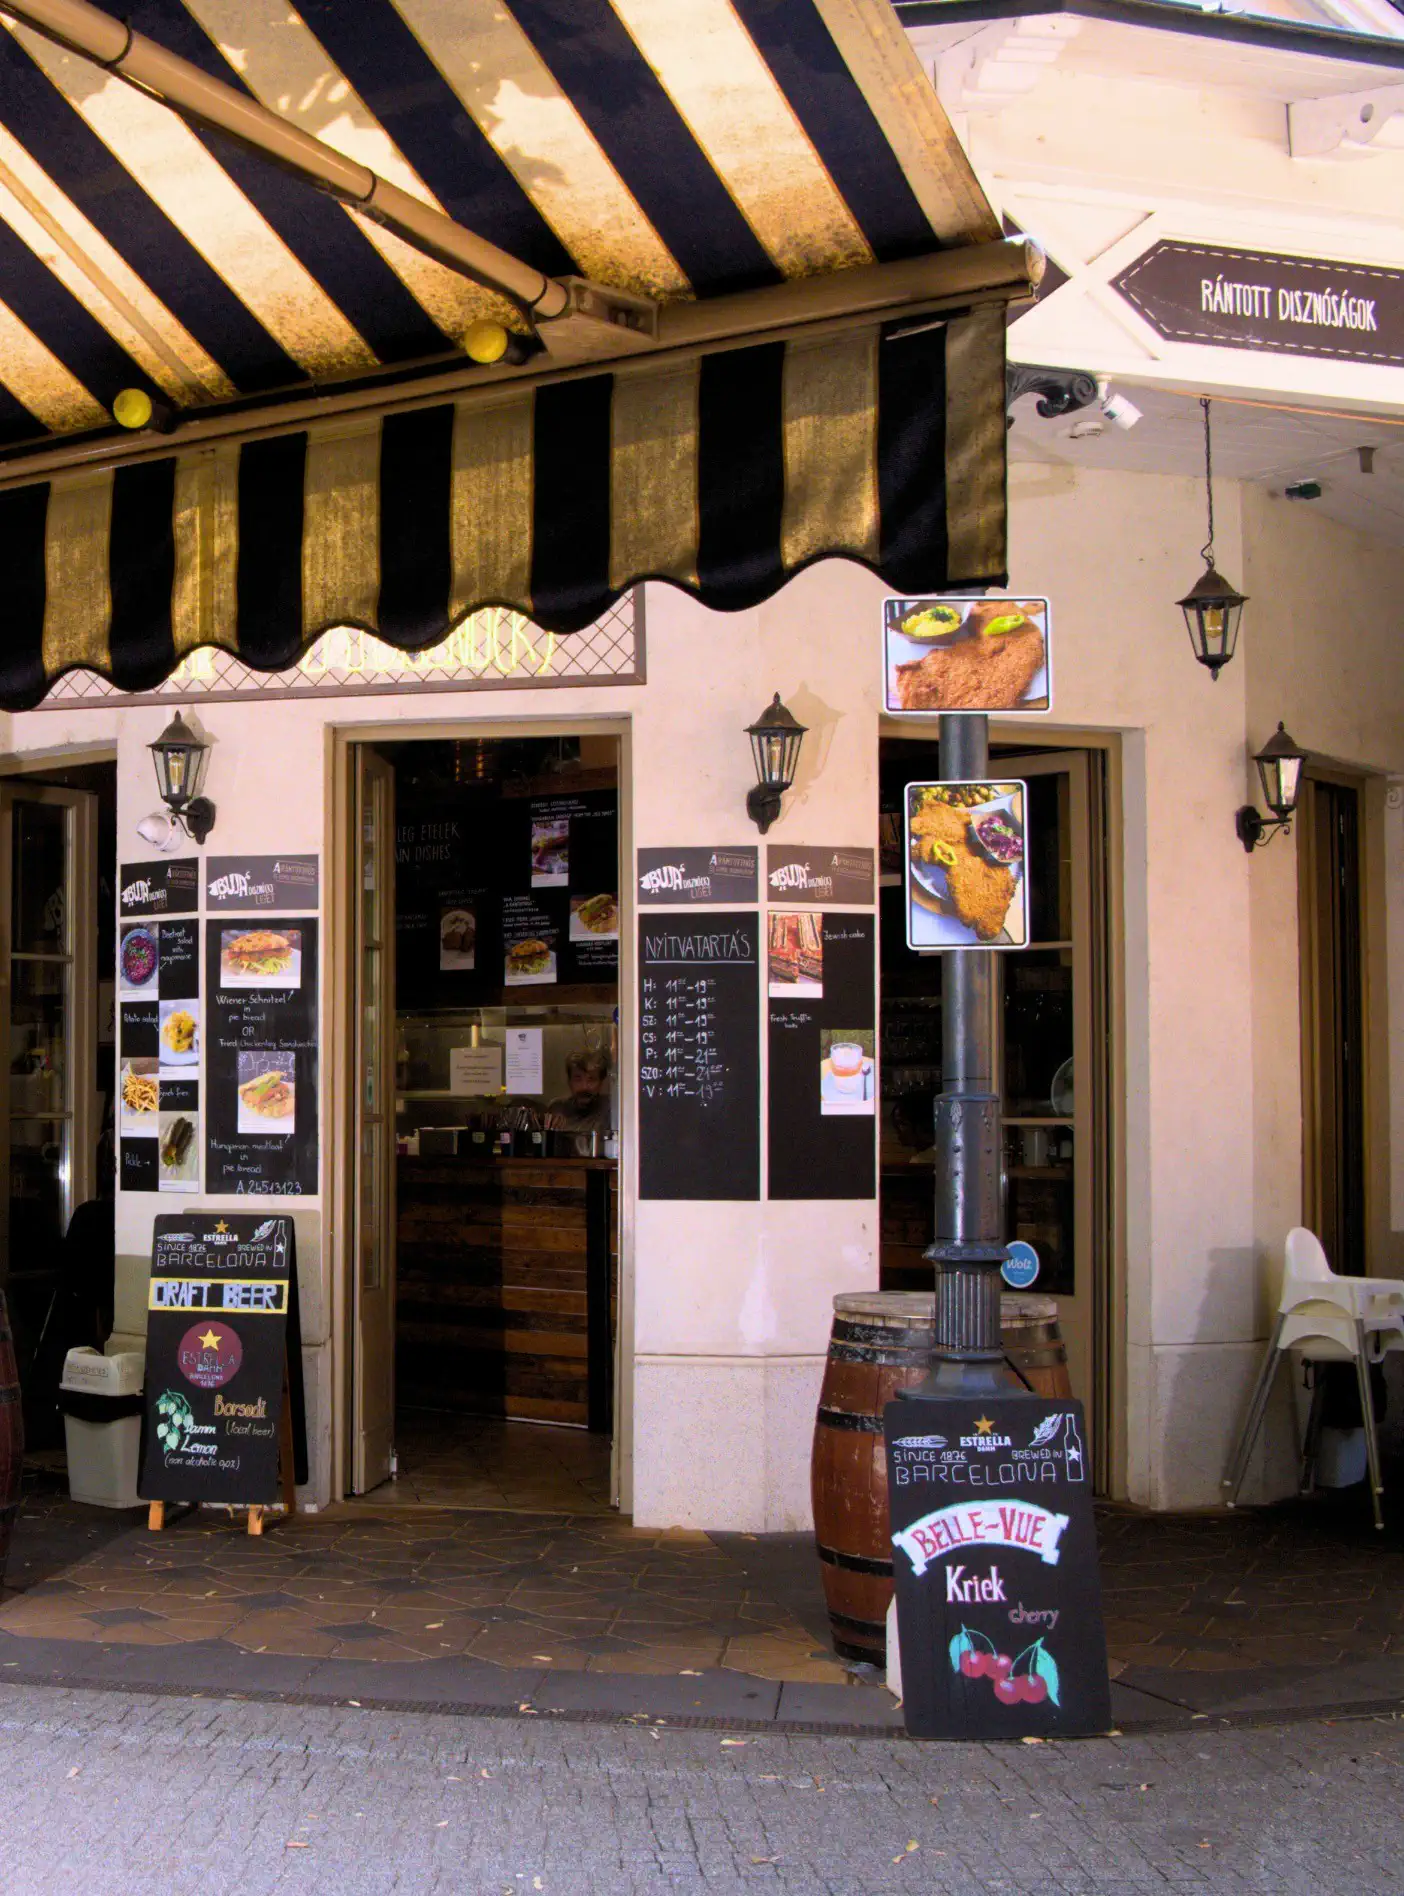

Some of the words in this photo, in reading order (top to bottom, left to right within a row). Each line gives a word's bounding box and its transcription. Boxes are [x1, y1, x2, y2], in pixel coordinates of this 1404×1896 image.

[1200, 273, 1271, 319] RÁNTOTT
[1277, 287, 1378, 331] DISZNÓSÁGOK
[643, 978, 656, 993] H:
[216, 995, 246, 1006] Wiener
[248, 993, 286, 1004] Schnitzel
[644, 997, 657, 1010] K:
[641, 1015, 657, 1027] SZ:
[242, 1026, 255, 1037] OR
[642, 1032, 657, 1044] CS:
[645, 1047, 658, 1060] P:
[640, 1065, 663, 1081] SZO:
[240, 1152, 248, 1160] in
[203, 1233, 238, 1242] ESTRELLA
[157, 1243, 185, 1252] SINCE
[236, 1243, 264, 1252] BREWED
[265, 1243, 273, 1251] IN
[156, 1252, 266, 1268] BARCELONA
[153, 1281, 211, 1307] DRAFT
[222, 1283, 277, 1310] BEER
[180, 1434, 218, 1456] Lemon
[960, 1436, 1012, 1447] ESTRELLA
[893, 1450, 936, 1464] SINCE
[939, 1451, 968, 1463] 1876
[1011, 1449, 1050, 1461] BREWED
[1052, 1450, 1063, 1459] IN
[895, 1462, 1057, 1486] BARCELONA
[910, 1507, 1047, 1559] BELLE-VUE
[945, 1565, 1007, 1604] Kriek
[1008, 1602, 1060, 1630] cherry
